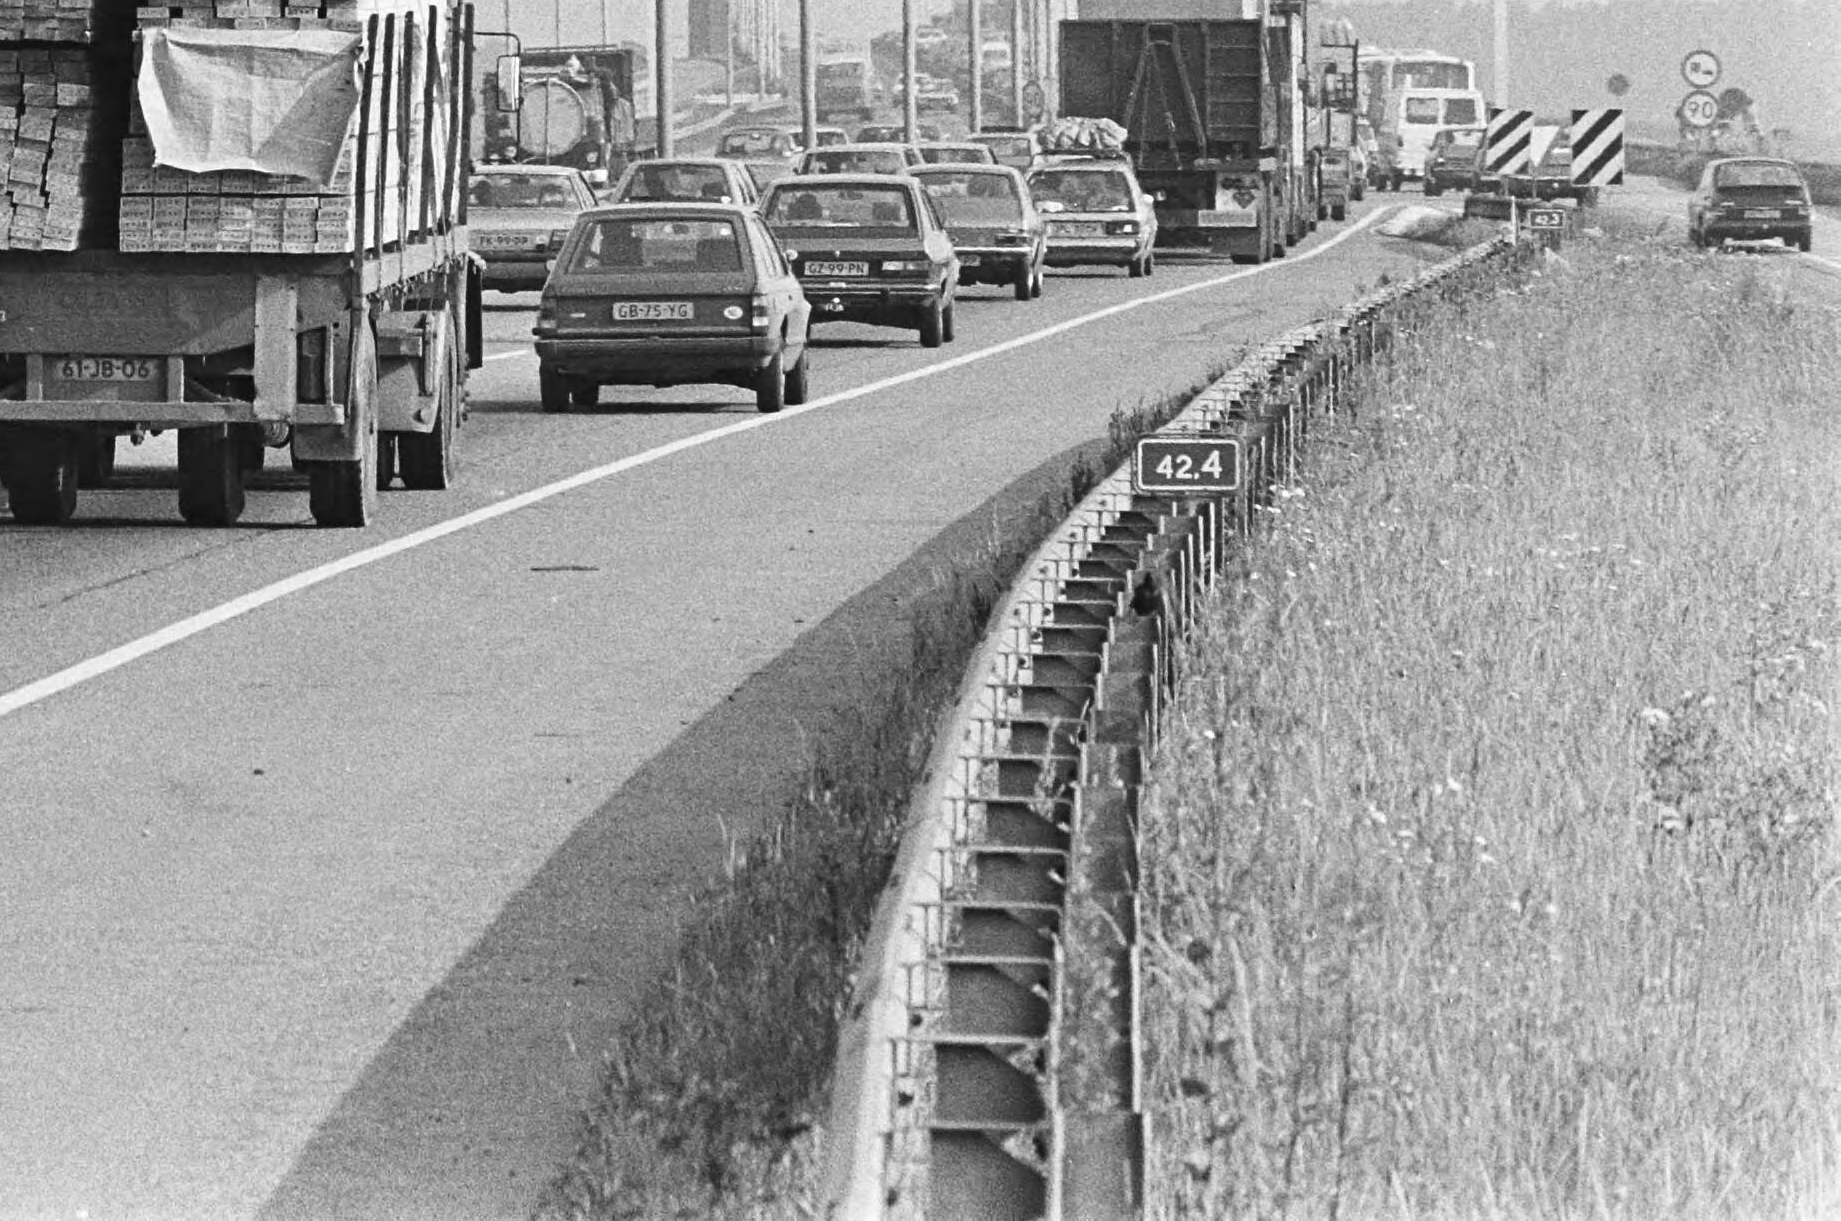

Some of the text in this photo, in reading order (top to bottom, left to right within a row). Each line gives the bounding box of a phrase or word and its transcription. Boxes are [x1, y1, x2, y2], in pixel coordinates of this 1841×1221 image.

[1688, 101, 1713, 118] 90
[618, 304, 688, 318] GB-75-YG
[62, 360, 150, 378] 61-JB-06
[1155, 450, 1223, 480] 42.4
